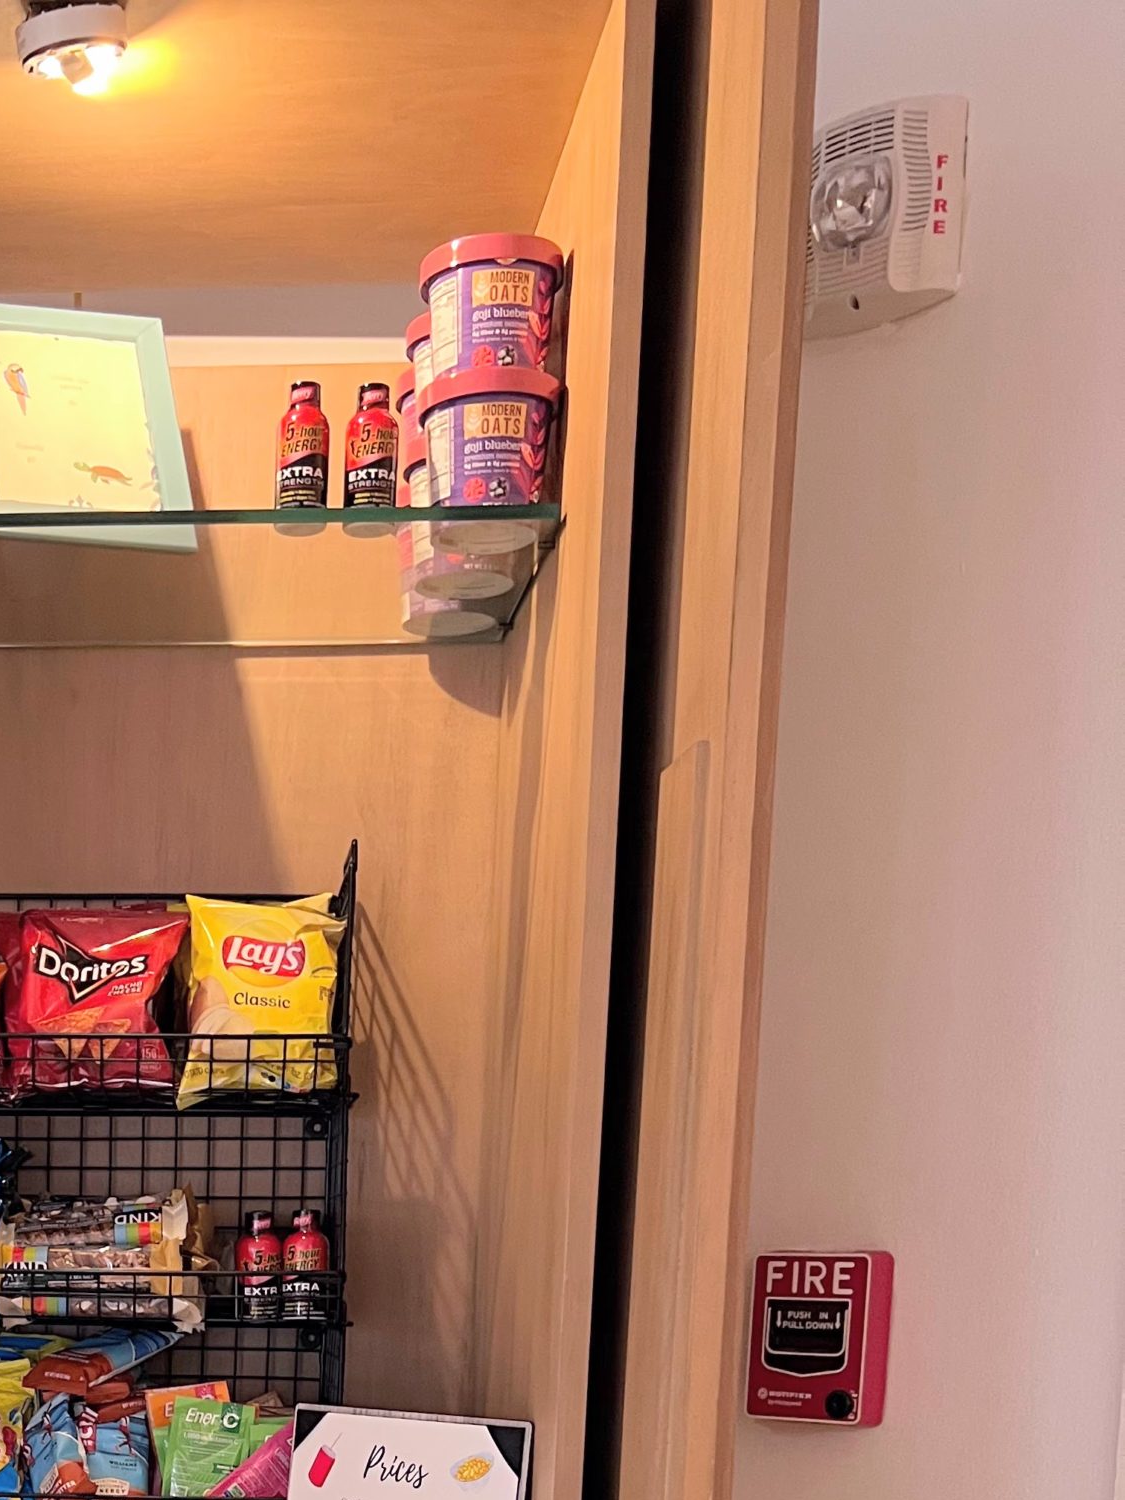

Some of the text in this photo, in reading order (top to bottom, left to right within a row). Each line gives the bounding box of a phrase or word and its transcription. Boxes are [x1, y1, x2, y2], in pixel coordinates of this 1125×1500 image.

[933, 154, 949, 234] FIRE
[490, 271, 530, 283] MODERN
[489, 285, 529, 303] OATS
[472, 307, 491, 322] goji
[482, 404, 522, 416] MODERN
[481, 418, 521, 435] OATS
[281, 438, 323, 457] ENERGY
[464, 443, 483, 455] goji
[278, 478, 324, 488] TRENGTH
[348, 468, 396, 483] EXTRA
[226, 937, 302, 975] Lay's
[38, 947, 146, 983] Doritos
[233, 992, 291, 1009] Classic
[114, 1211, 162, 1225] KIND
[766, 1261, 855, 1295] FIRE
[244, 1286, 278, 1296] EXTR
[787, 1310, 829, 1320] PUSH IN
[782, 1321, 834, 1330] PULL DOWN
[363, 1445, 429, 1489] Prices
